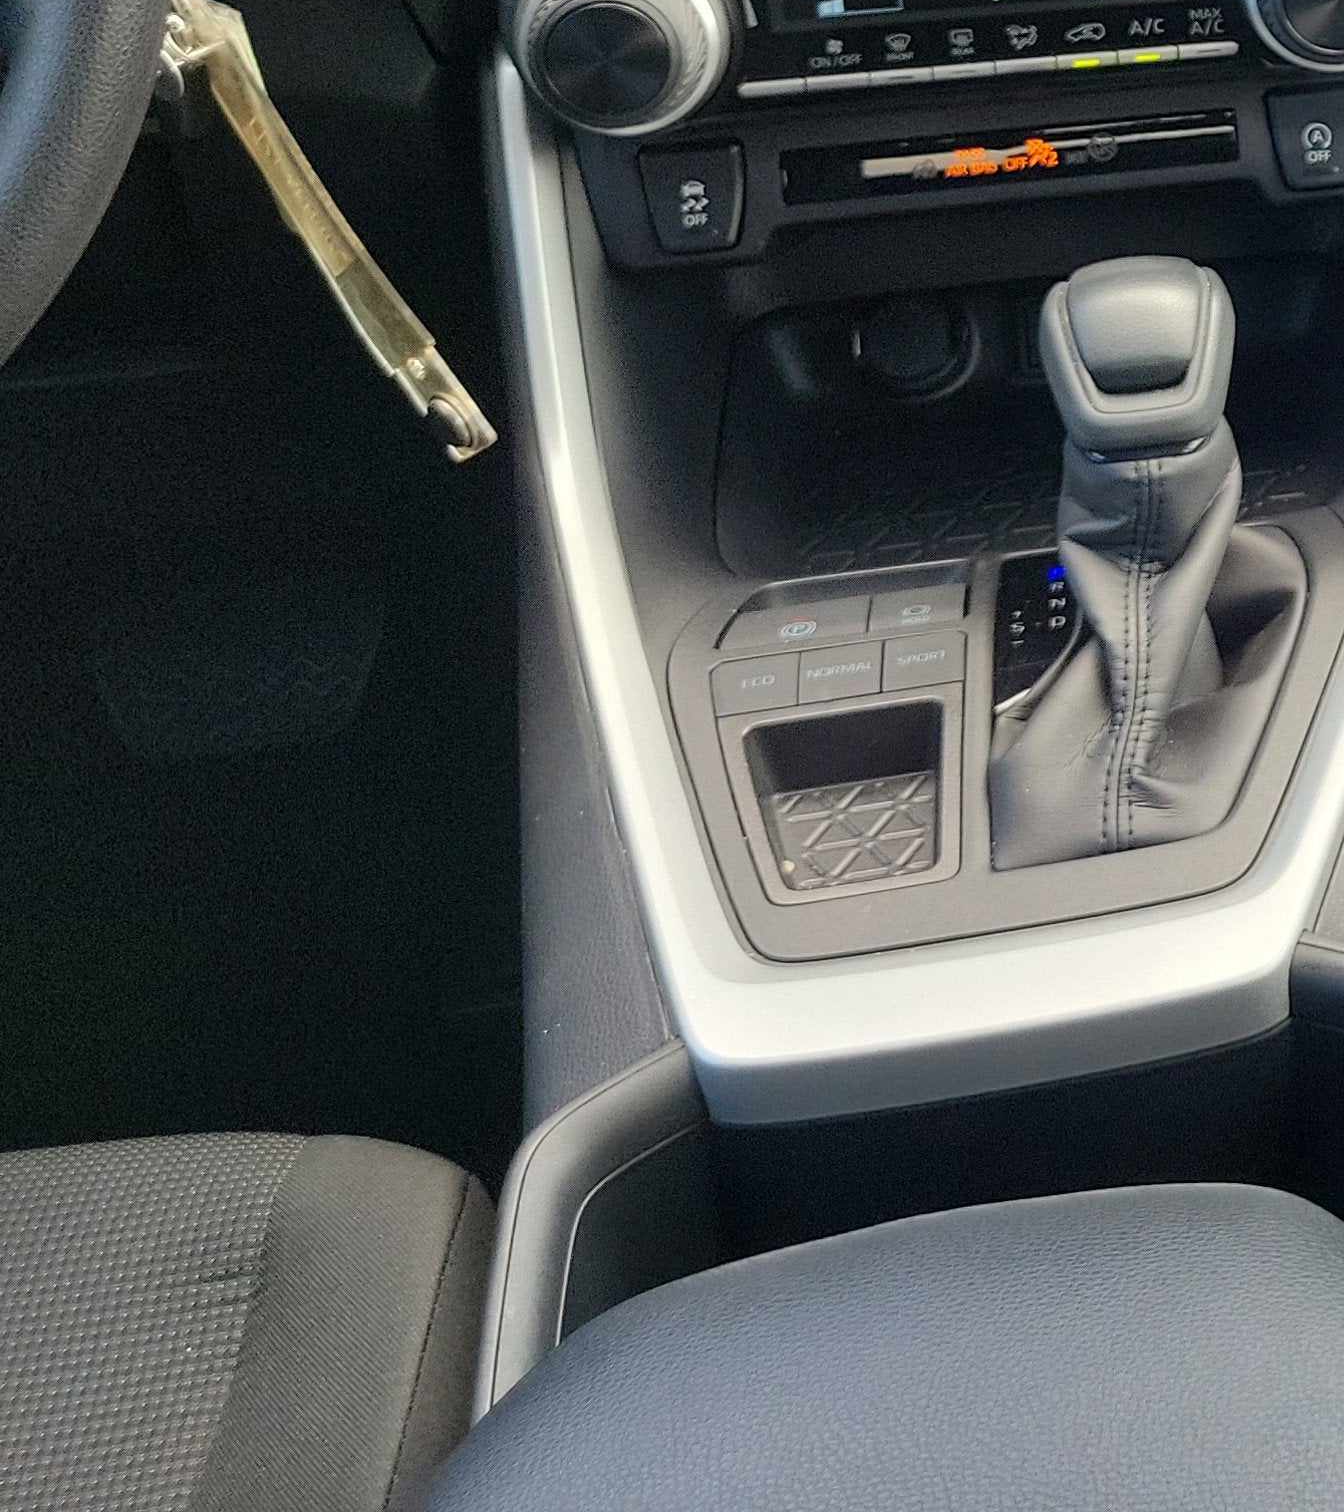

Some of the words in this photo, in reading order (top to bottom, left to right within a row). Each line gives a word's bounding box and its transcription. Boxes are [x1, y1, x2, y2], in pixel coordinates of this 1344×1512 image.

[1189, 8, 1222, 20] MAX
[1127, 18, 1166, 36] A/C
[1190, 18, 1225, 36] A/C
[1304, 149, 1332, 165] OFF
[682, 213, 709, 228] OFF
[806, 661, 873, 678] NORMAL
